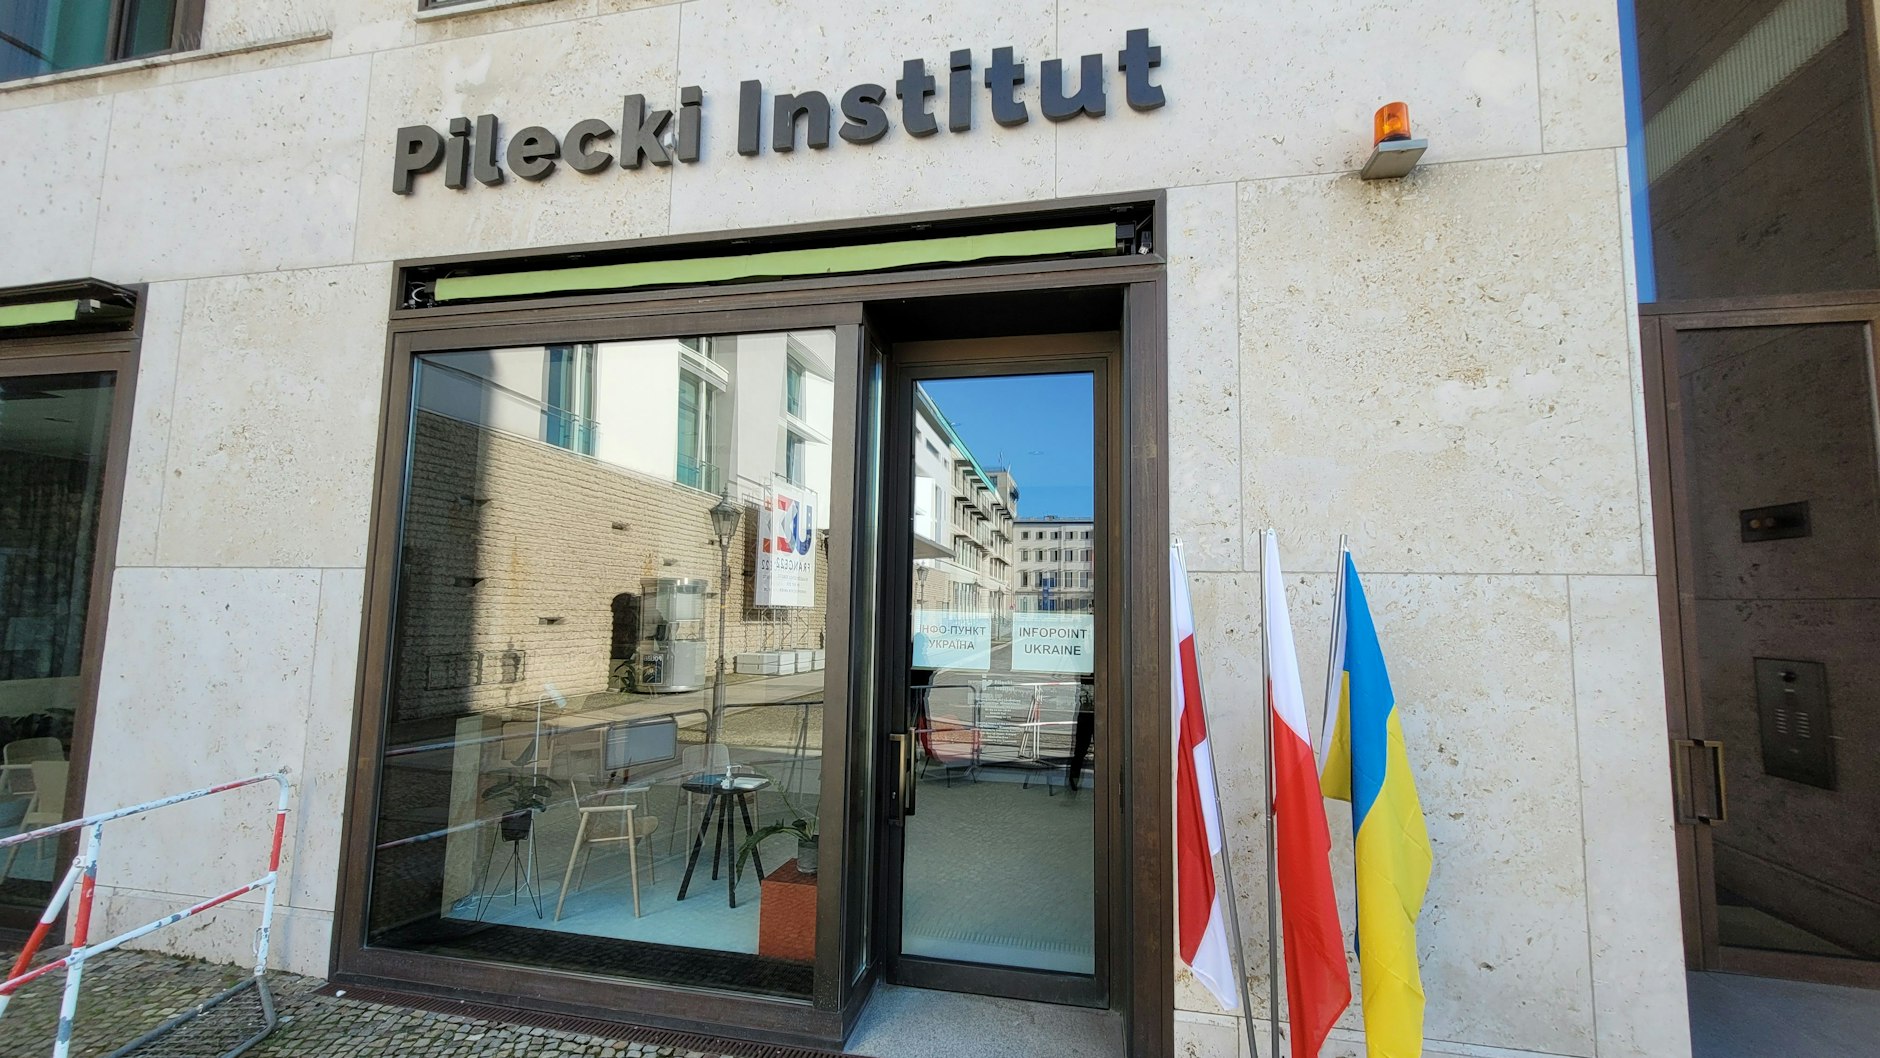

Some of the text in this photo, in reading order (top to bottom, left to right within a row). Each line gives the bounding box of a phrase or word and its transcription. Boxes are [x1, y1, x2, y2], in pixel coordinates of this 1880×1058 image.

[392, 27, 1166, 195] Pilecki Institut
[1019, 627, 1088, 639] INFOPOINT
[929, 638, 975, 650] УКРАЇНА
[1024, 643, 1082, 656] UKRAINE
